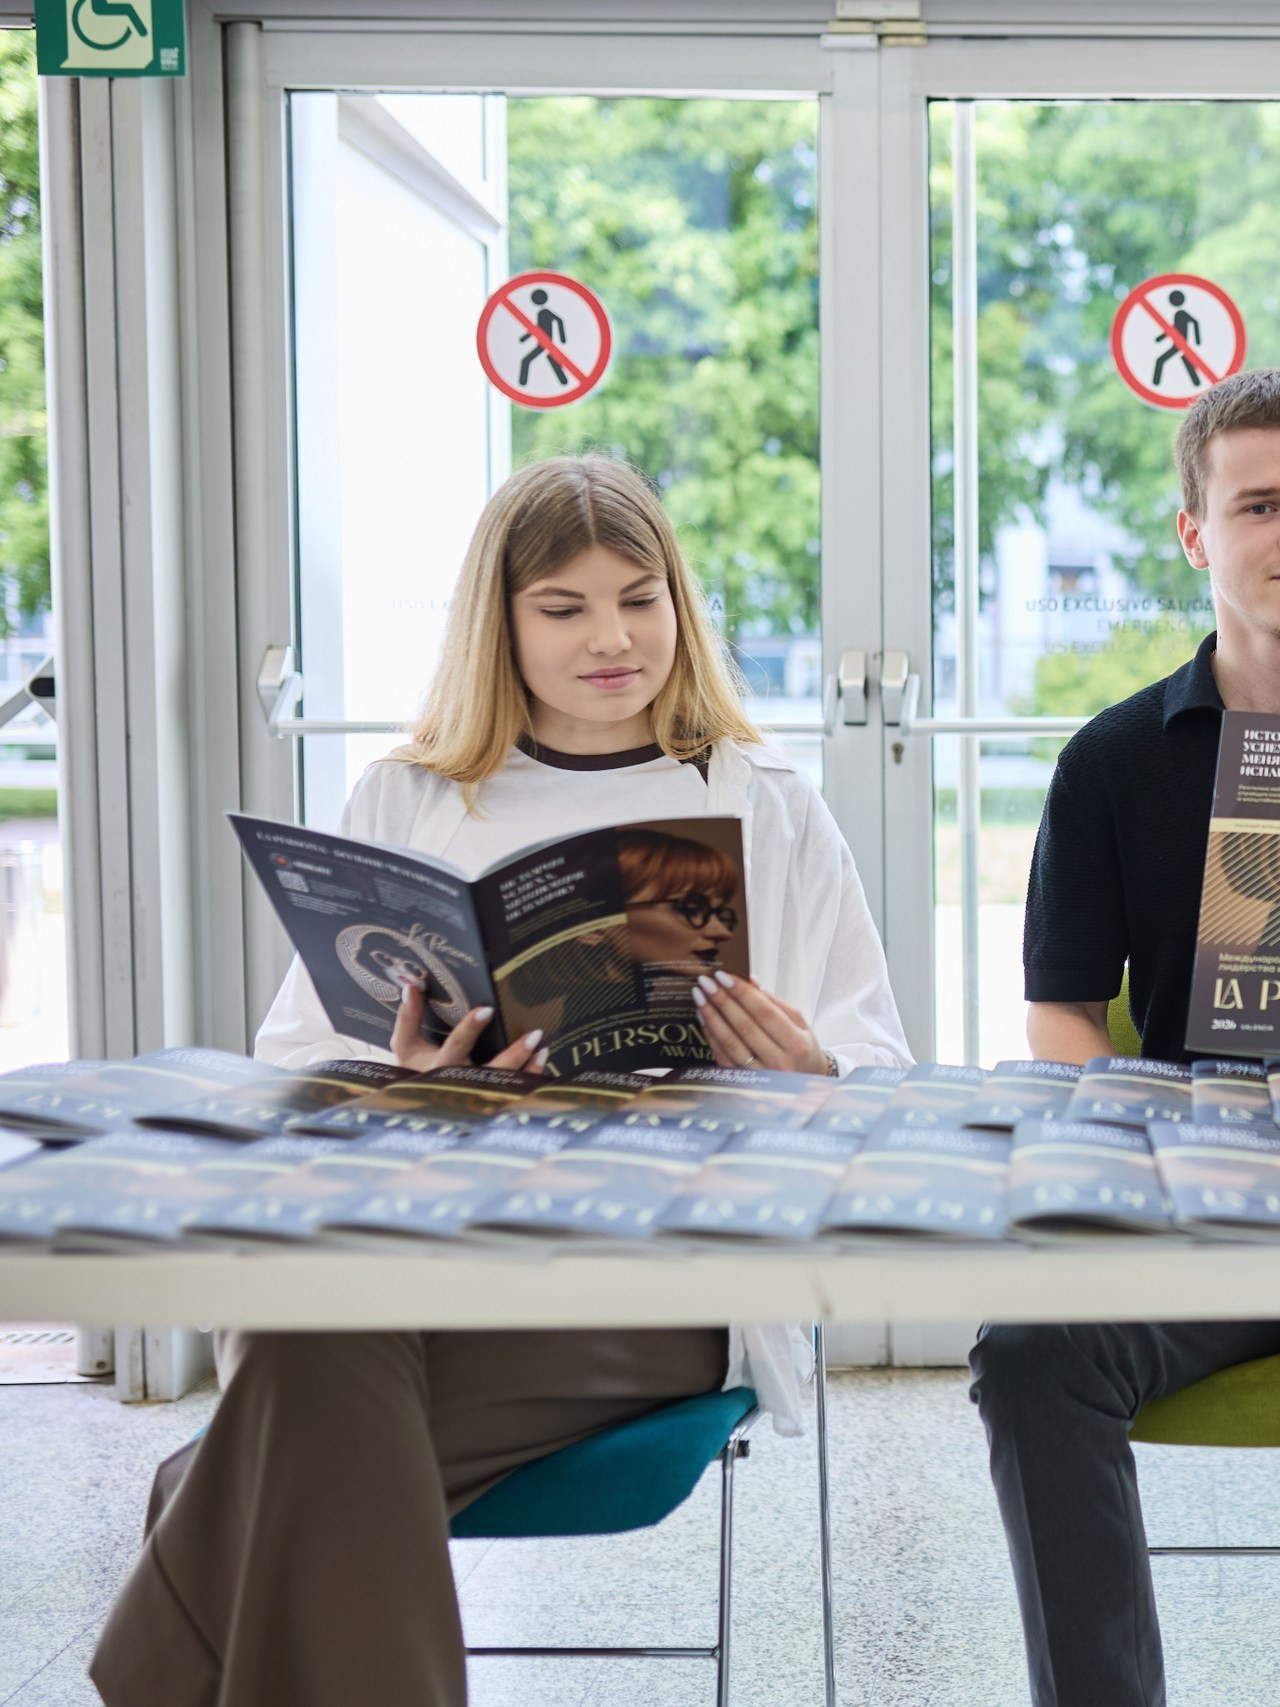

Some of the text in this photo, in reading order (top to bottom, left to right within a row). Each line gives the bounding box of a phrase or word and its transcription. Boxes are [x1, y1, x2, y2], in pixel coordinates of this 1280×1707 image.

[1025, 596, 1058, 613] USO
[1063, 596, 1152, 613] EXCLUSIVO
[1213, 977, 1244, 1010] LA
[571, 1022, 708, 1067] PERSON
[660, 1044, 715, 1061] AWAR
